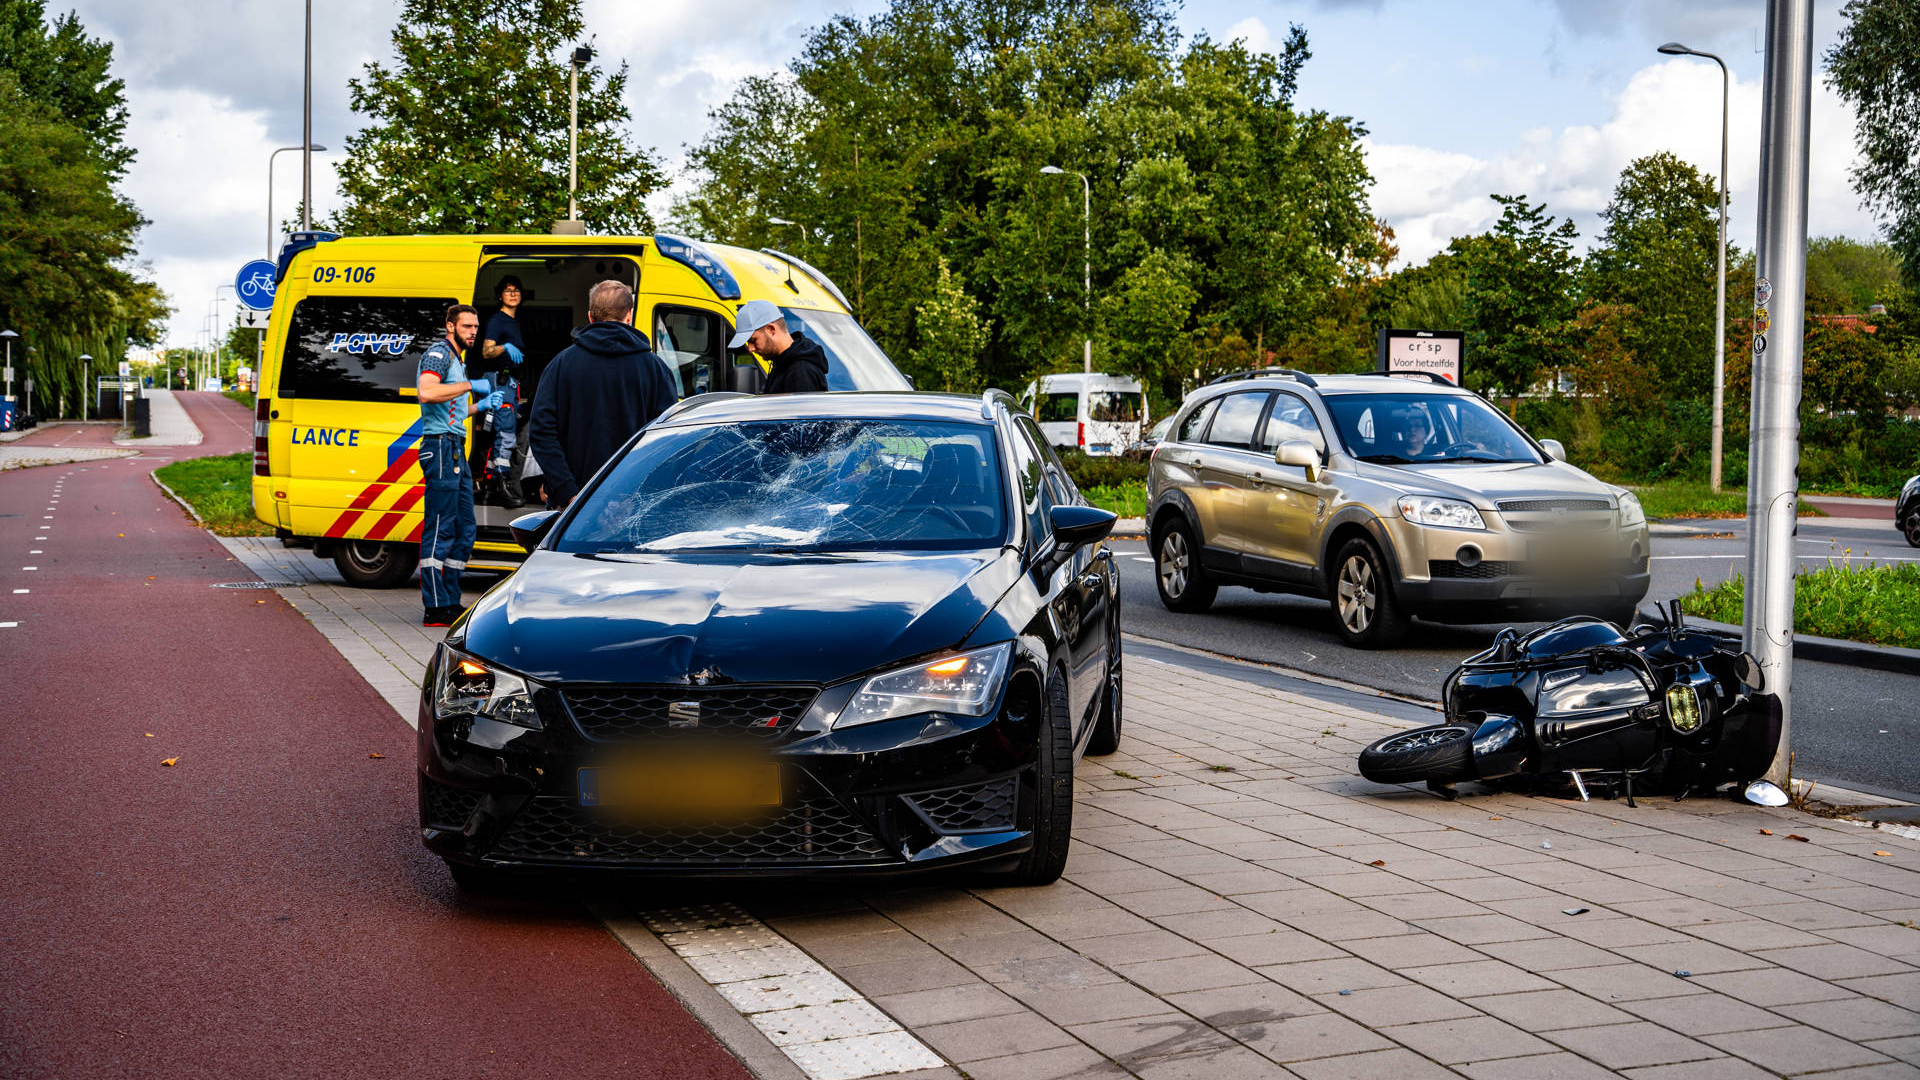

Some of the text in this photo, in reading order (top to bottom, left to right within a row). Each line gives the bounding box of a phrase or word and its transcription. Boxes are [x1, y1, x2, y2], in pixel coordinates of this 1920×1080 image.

[313, 266, 376, 283] 09-106
[1393, 357, 1455, 368] Voor hetzelfde
[291, 427, 360, 447] LANCE
[583, 792, 597, 800] NL
